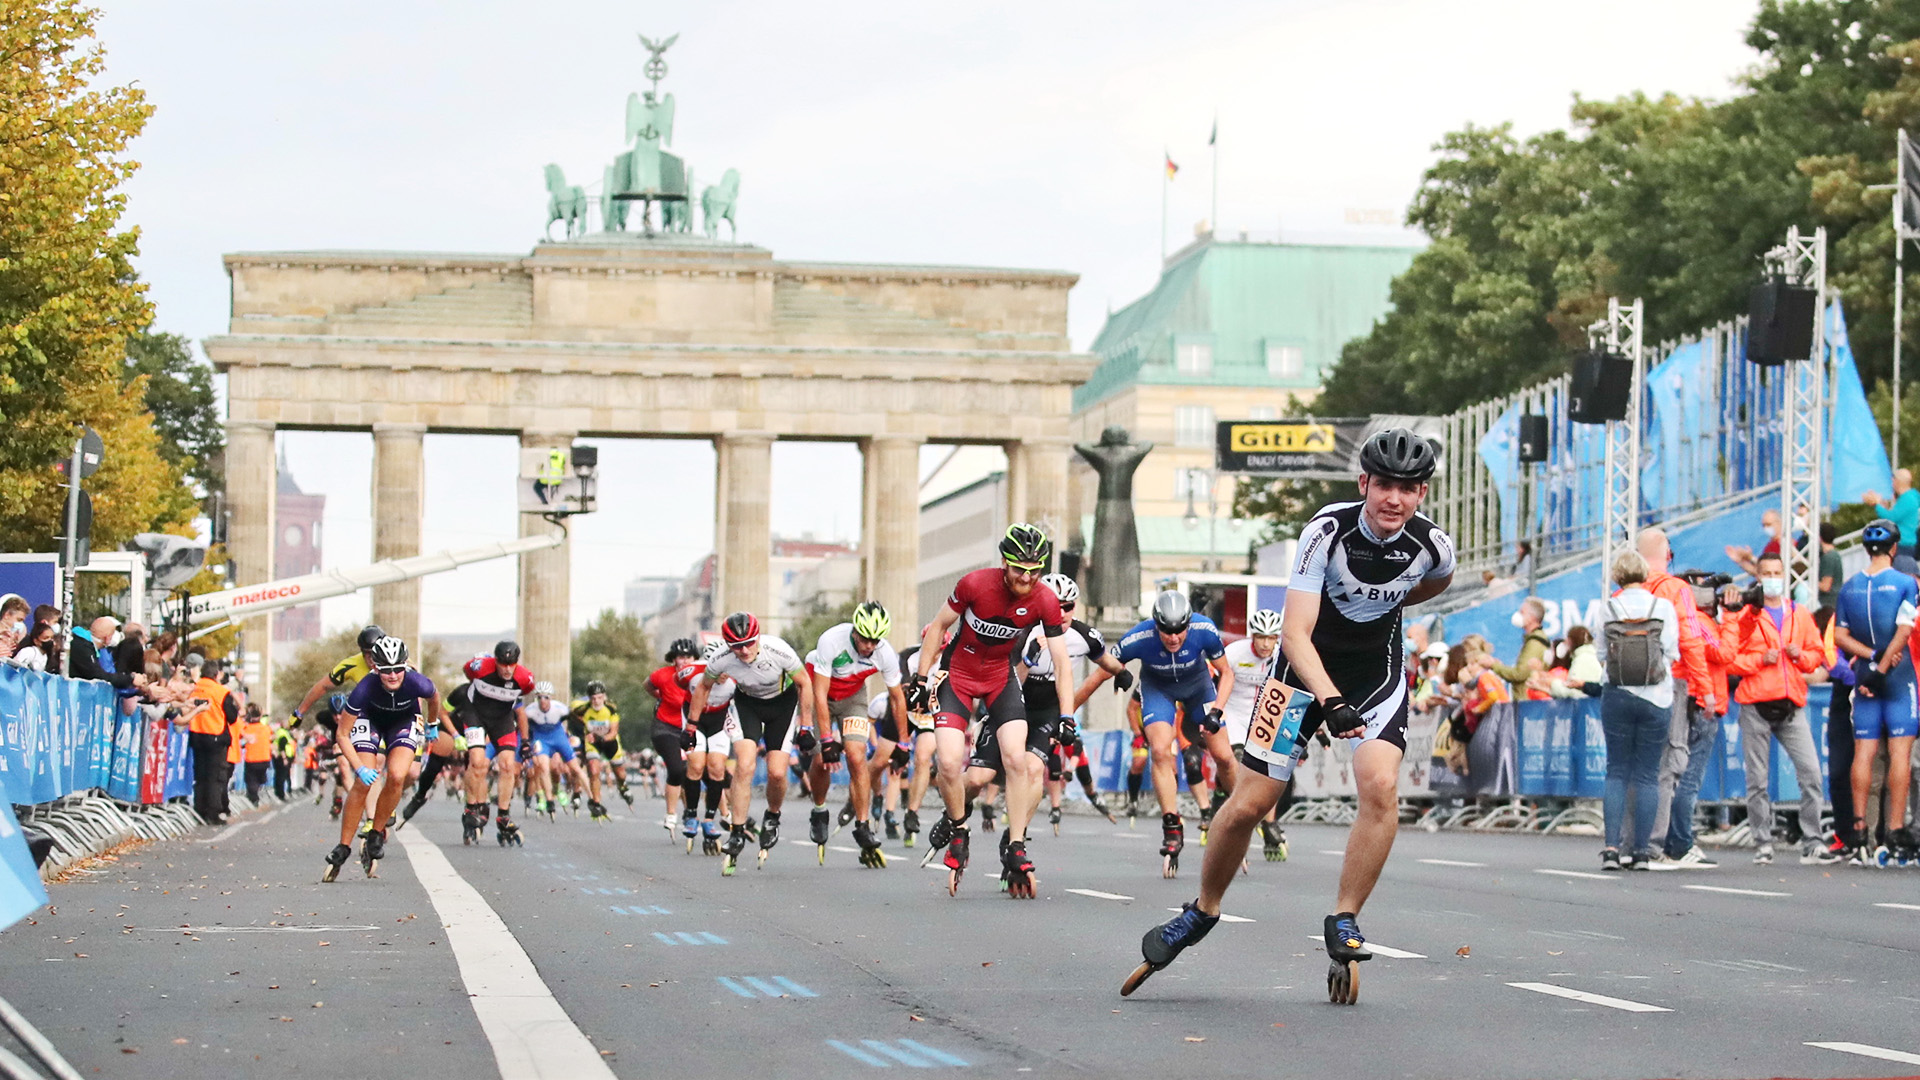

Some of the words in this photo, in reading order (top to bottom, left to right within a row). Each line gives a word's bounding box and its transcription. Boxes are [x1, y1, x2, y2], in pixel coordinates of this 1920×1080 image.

[1240, 431, 1293, 446] Giti
[232, 584, 301, 607] mateco
[1255, 687, 1287, 743] 6916
